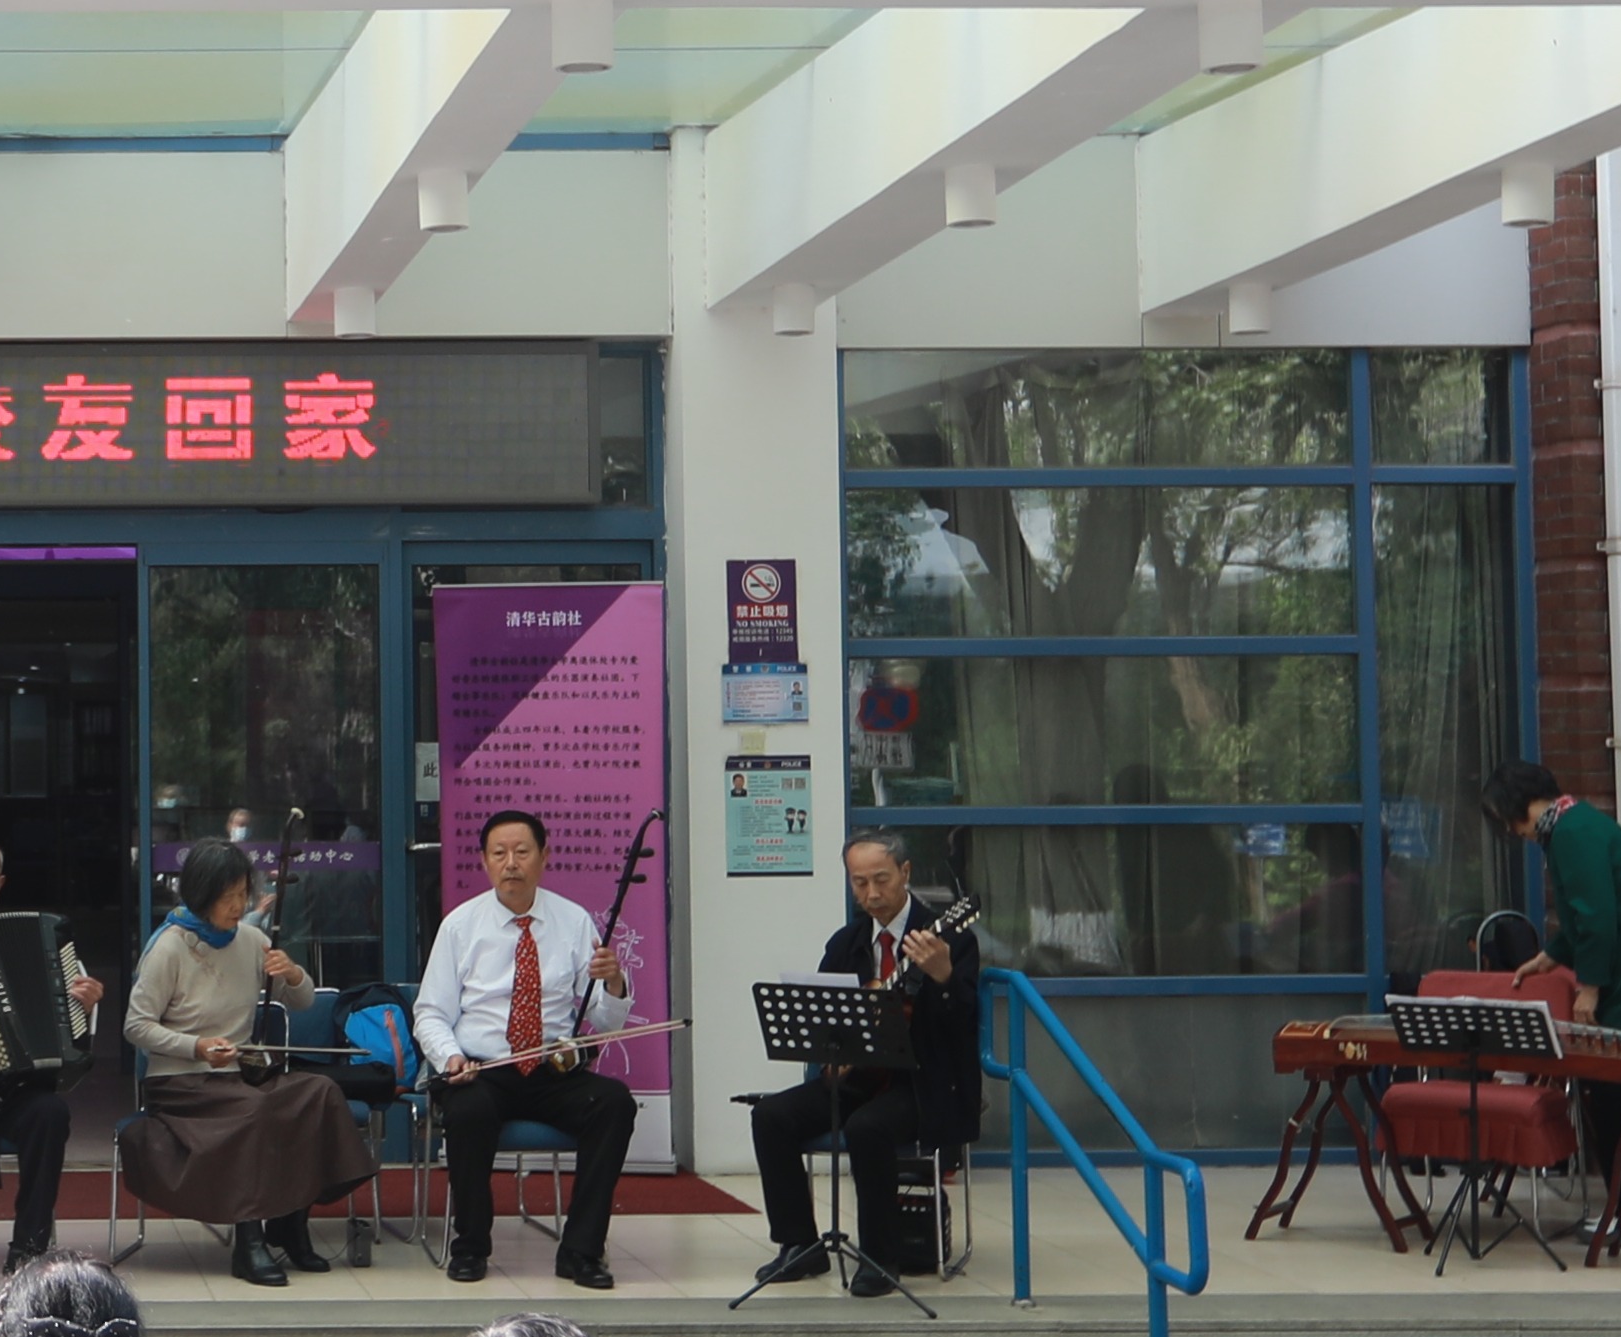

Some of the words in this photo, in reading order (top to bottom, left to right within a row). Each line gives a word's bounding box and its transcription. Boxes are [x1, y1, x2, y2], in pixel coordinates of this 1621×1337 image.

[736, 605, 788, 618] 禁止吸烟
[506, 611, 582, 627] 清华古韵社
[736, 619, 748, 627] NO
[750, 619, 789, 627] SMOKING
[423, 761, 438, 778] 此
